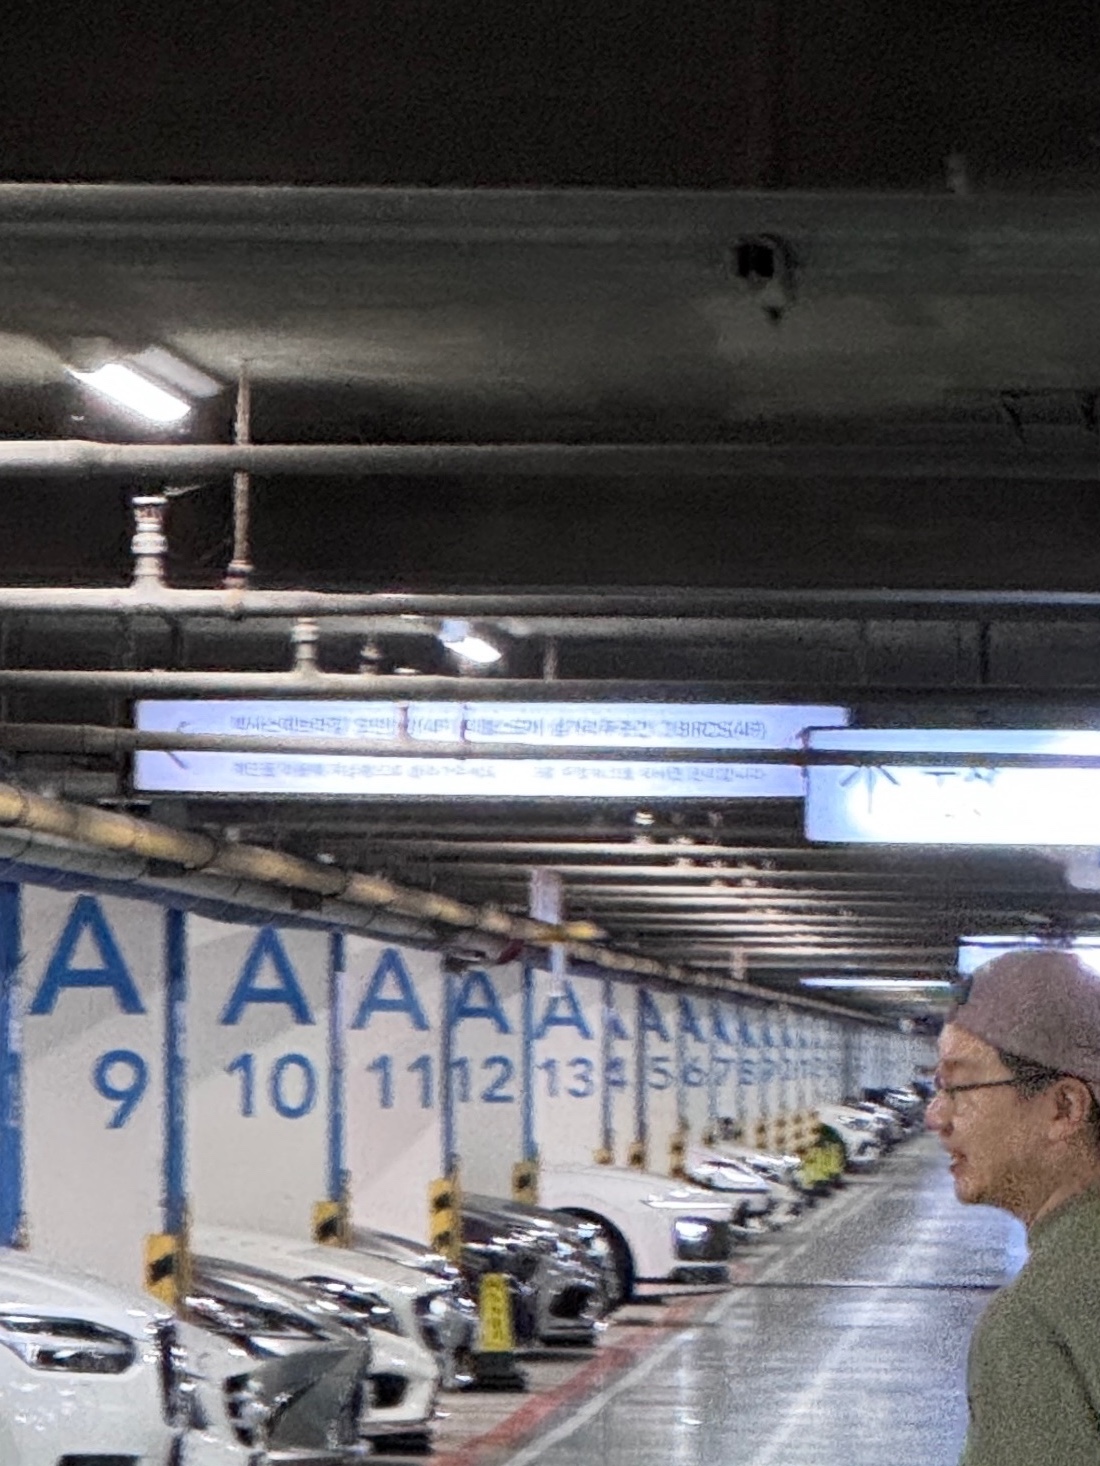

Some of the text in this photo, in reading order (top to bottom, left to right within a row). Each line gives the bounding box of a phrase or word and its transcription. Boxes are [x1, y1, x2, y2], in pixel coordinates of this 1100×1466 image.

[28, 894, 147, 1016] A
[219, 925, 317, 1026] A
[350, 948, 431, 1031] A
[450, 970, 511, 1034] A
[535, 975, 593, 1039] A
[95, 1049, 149, 1129] 9
[226, 1053, 317, 1119] 10
[367, 1054, 433, 1109] 11
[451, 1055, 515, 1103] 12
[536, 1057, 596, 1098] 13
